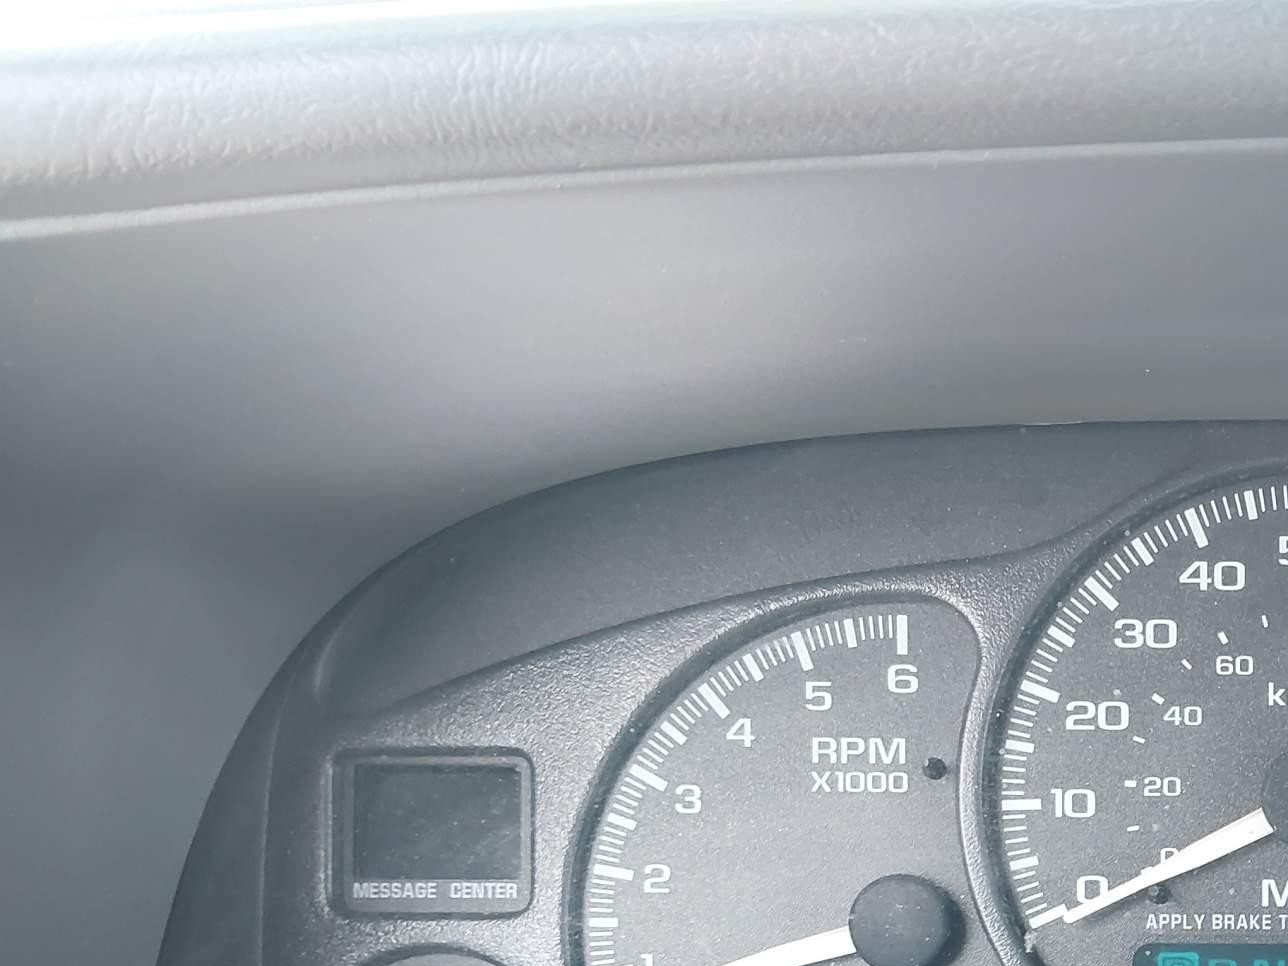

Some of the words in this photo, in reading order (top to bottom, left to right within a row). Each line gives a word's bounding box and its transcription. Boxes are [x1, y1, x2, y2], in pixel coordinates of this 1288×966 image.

[1179, 561, 1246, 591] 40
[1113, 619, 1177, 649] 30
[886, 664, 918, 694] 6
[1215, 656, 1254, 676] 60
[804, 682, 833, 711] 5
[1066, 702, 1129, 731] 20
[1163, 706, 1203, 726] 40
[726, 718, 755, 747] 4
[811, 737, 906, 764] RPM
[810, 771, 909, 793] X1000
[1143, 777, 1181, 797] 20
[675, 786, 702, 813] 3
[1050, 789, 1096, 818] 10
[353, 882, 437, 899] MESSAGE
[449, 882, 518, 899] CENTER
[643, 866, 671, 894] 2
[1076, 876, 1109, 905] 0
[1145, 914, 1204, 930] APPLY
[1211, 914, 1272, 930] BRAKE
